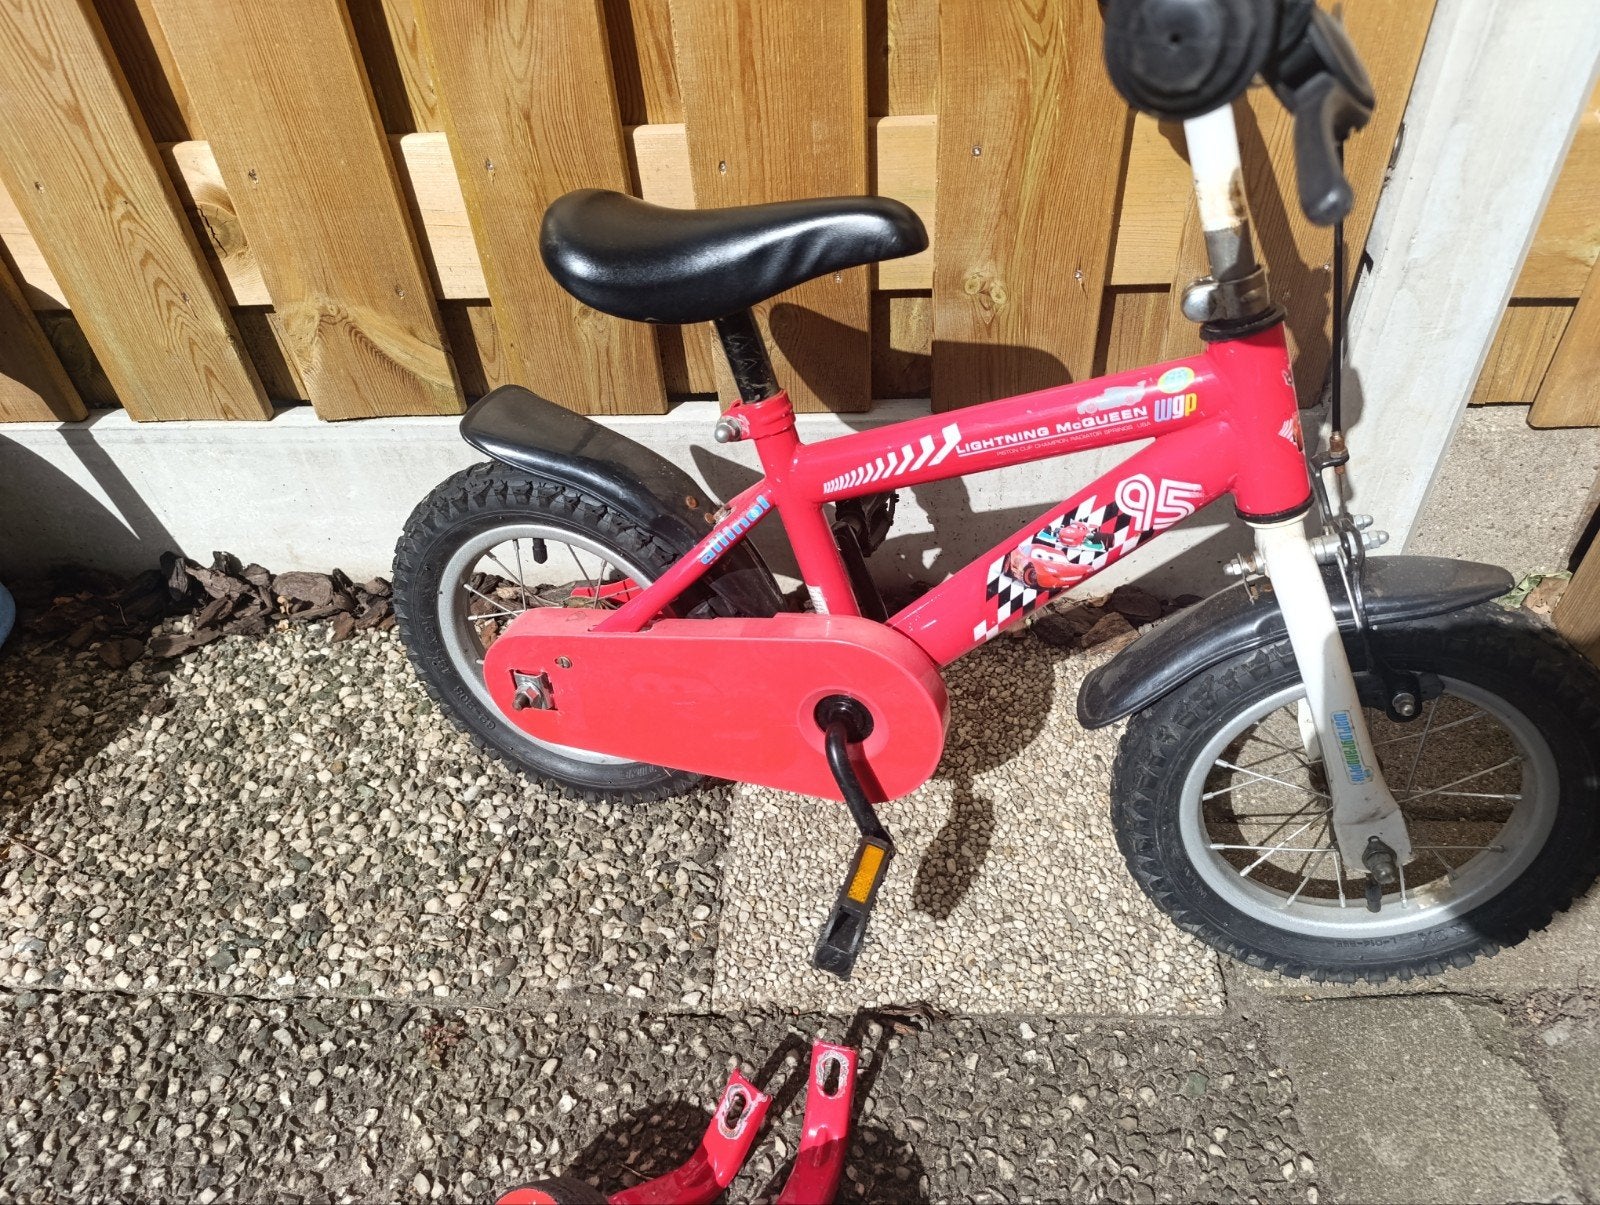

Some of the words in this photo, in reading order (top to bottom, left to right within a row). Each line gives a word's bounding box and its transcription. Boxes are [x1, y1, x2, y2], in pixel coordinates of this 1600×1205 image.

[1154, 392, 1197, 422] wgp
[955, 426, 1050, 454] LIGHTNING
[1056, 405, 1148, 433] McQUEEN
[996, 447, 1019, 457] PISTON
[1019, 445, 1032, 453] CUP
[1034, 438, 1070, 449] CHAMPION
[1070, 431, 1102, 442] RADIATOR
[1104, 424, 1133, 435] SPRINGS
[1114, 473, 1205, 532] 95
